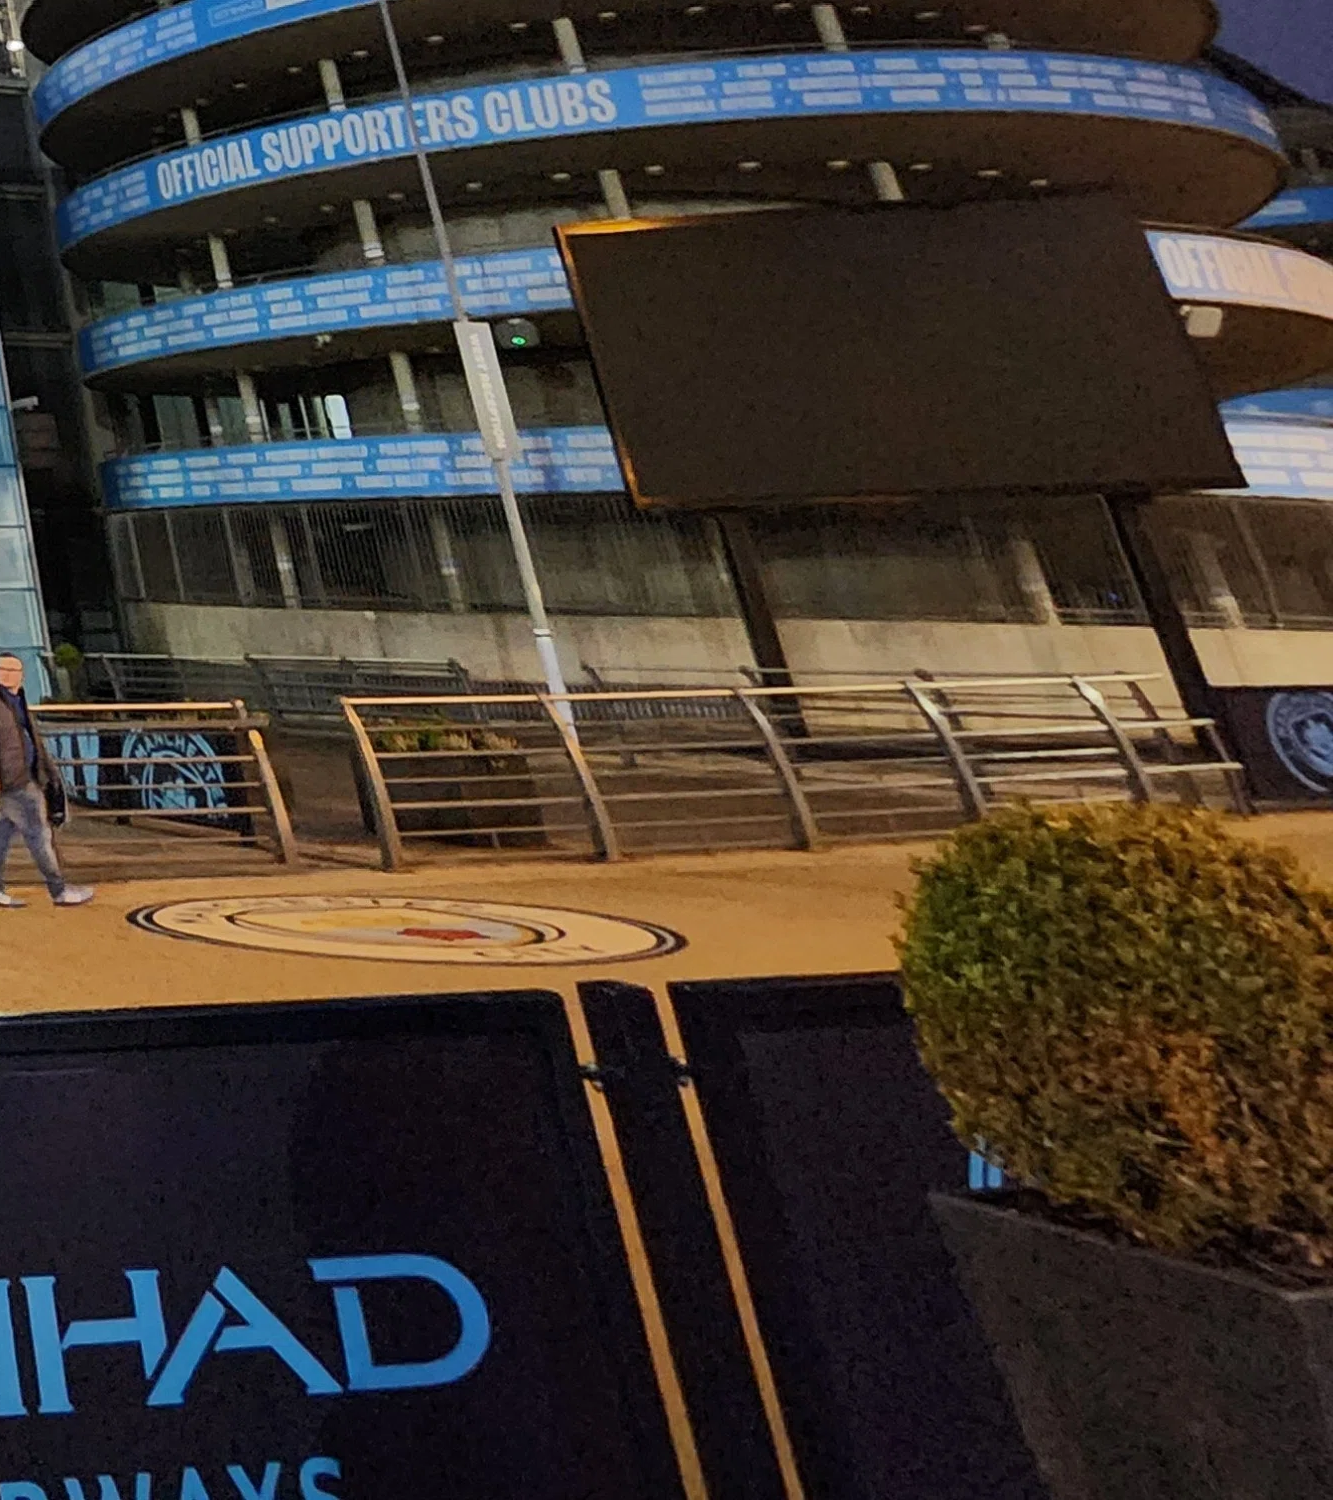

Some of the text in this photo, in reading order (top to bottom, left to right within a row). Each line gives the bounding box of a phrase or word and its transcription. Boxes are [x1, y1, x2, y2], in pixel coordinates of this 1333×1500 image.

[156, 141, 261, 201] OFFICIAL
[261, 95, 478, 174] SUPPORTERS
[483, 79, 618, 134] CLUBS
